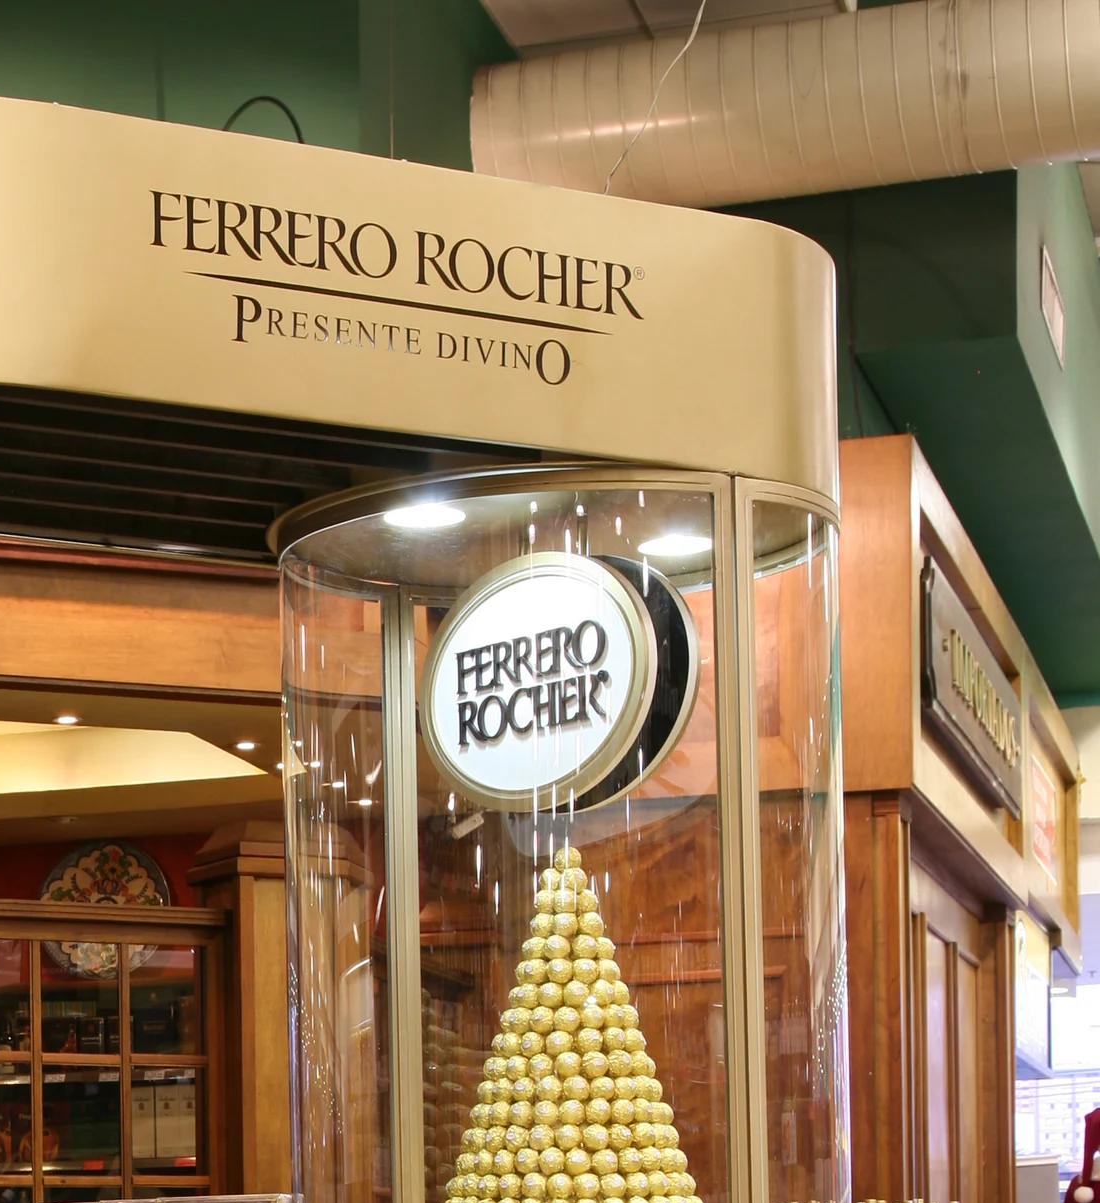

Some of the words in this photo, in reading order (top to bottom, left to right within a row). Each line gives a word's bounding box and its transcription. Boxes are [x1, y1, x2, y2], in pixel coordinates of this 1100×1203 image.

[149, 190, 398, 279] FERRERO
[231, 294, 423, 356] PRESENTE
[437, 331, 571, 386] DIVINO
[455, 619, 607, 696] FERRERO
